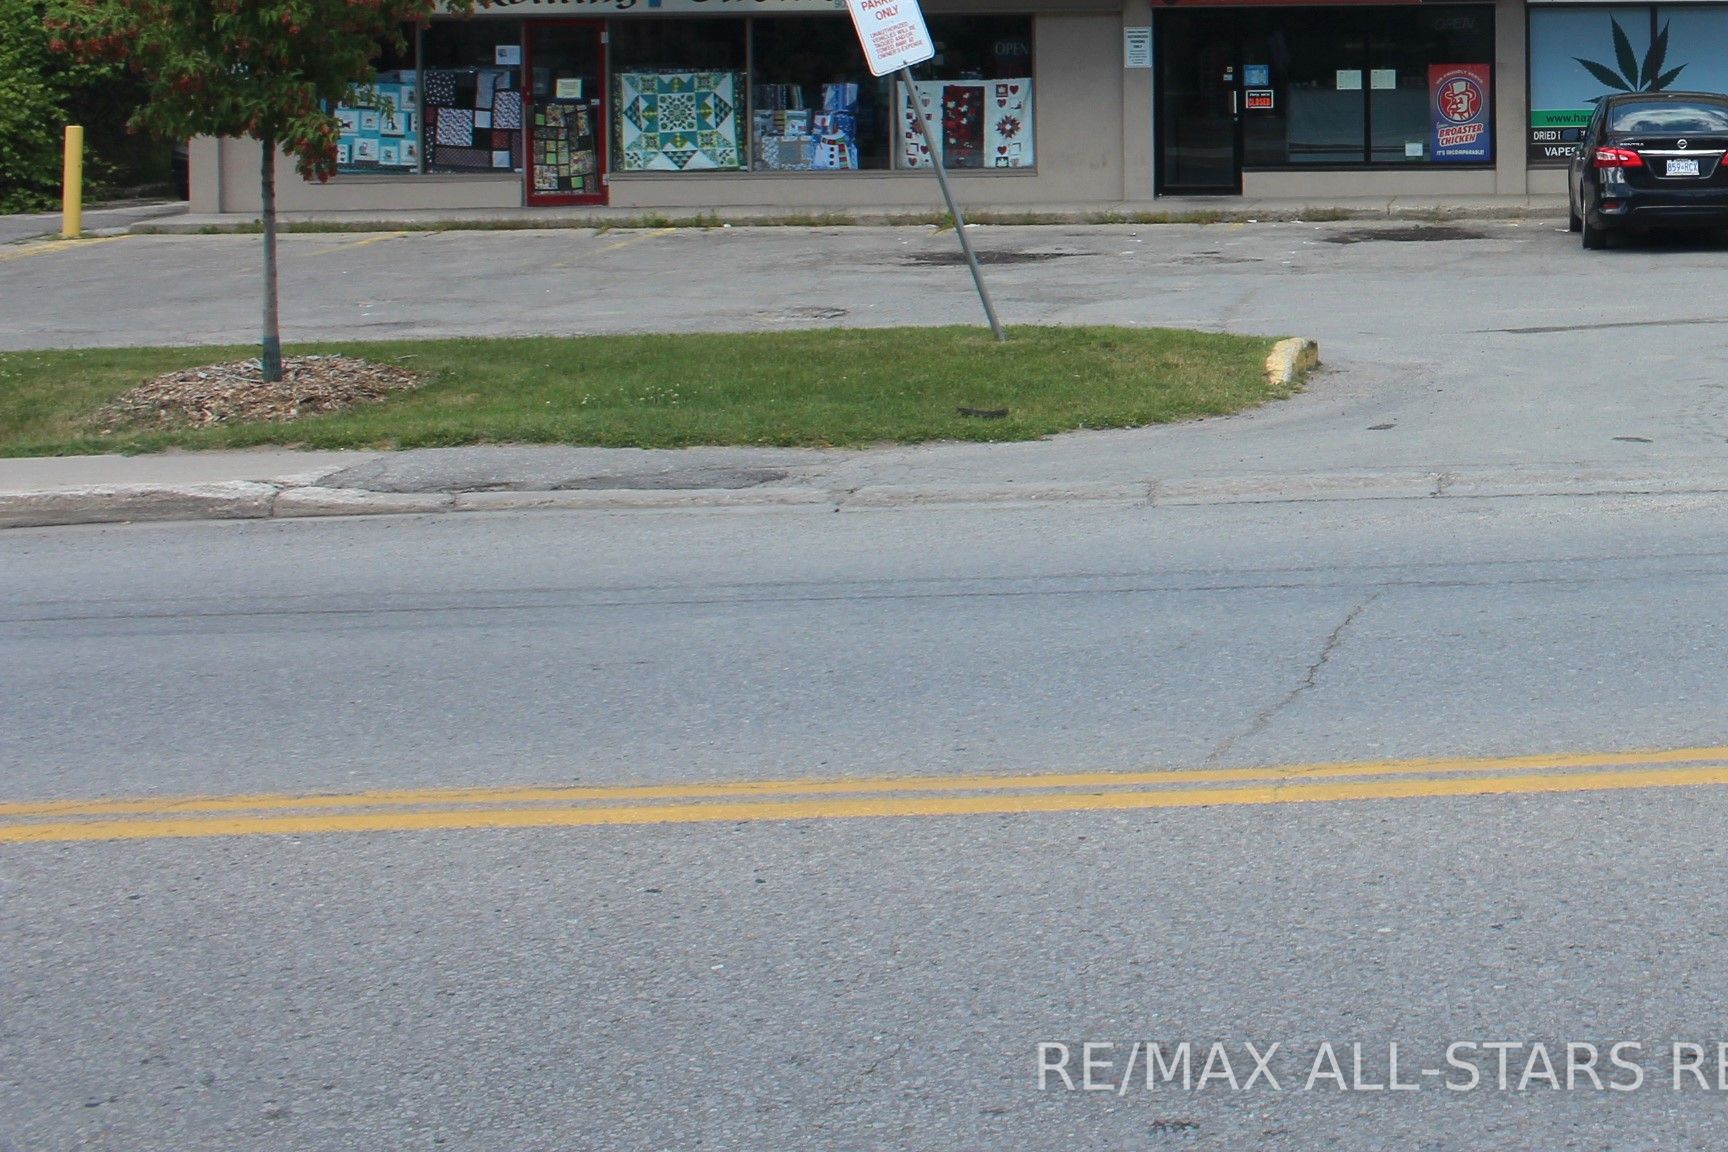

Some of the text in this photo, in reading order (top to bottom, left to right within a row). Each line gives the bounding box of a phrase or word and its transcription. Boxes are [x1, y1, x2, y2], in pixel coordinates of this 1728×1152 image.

[875, 5, 899, 20] ONLY
[995, 42, 1029, 56] OPEN
[1439, 124, 1483, 138] BROASTER
[1533, 131, 1557, 140] DRIED
[1440, 133, 1476, 146] CHICKEN
